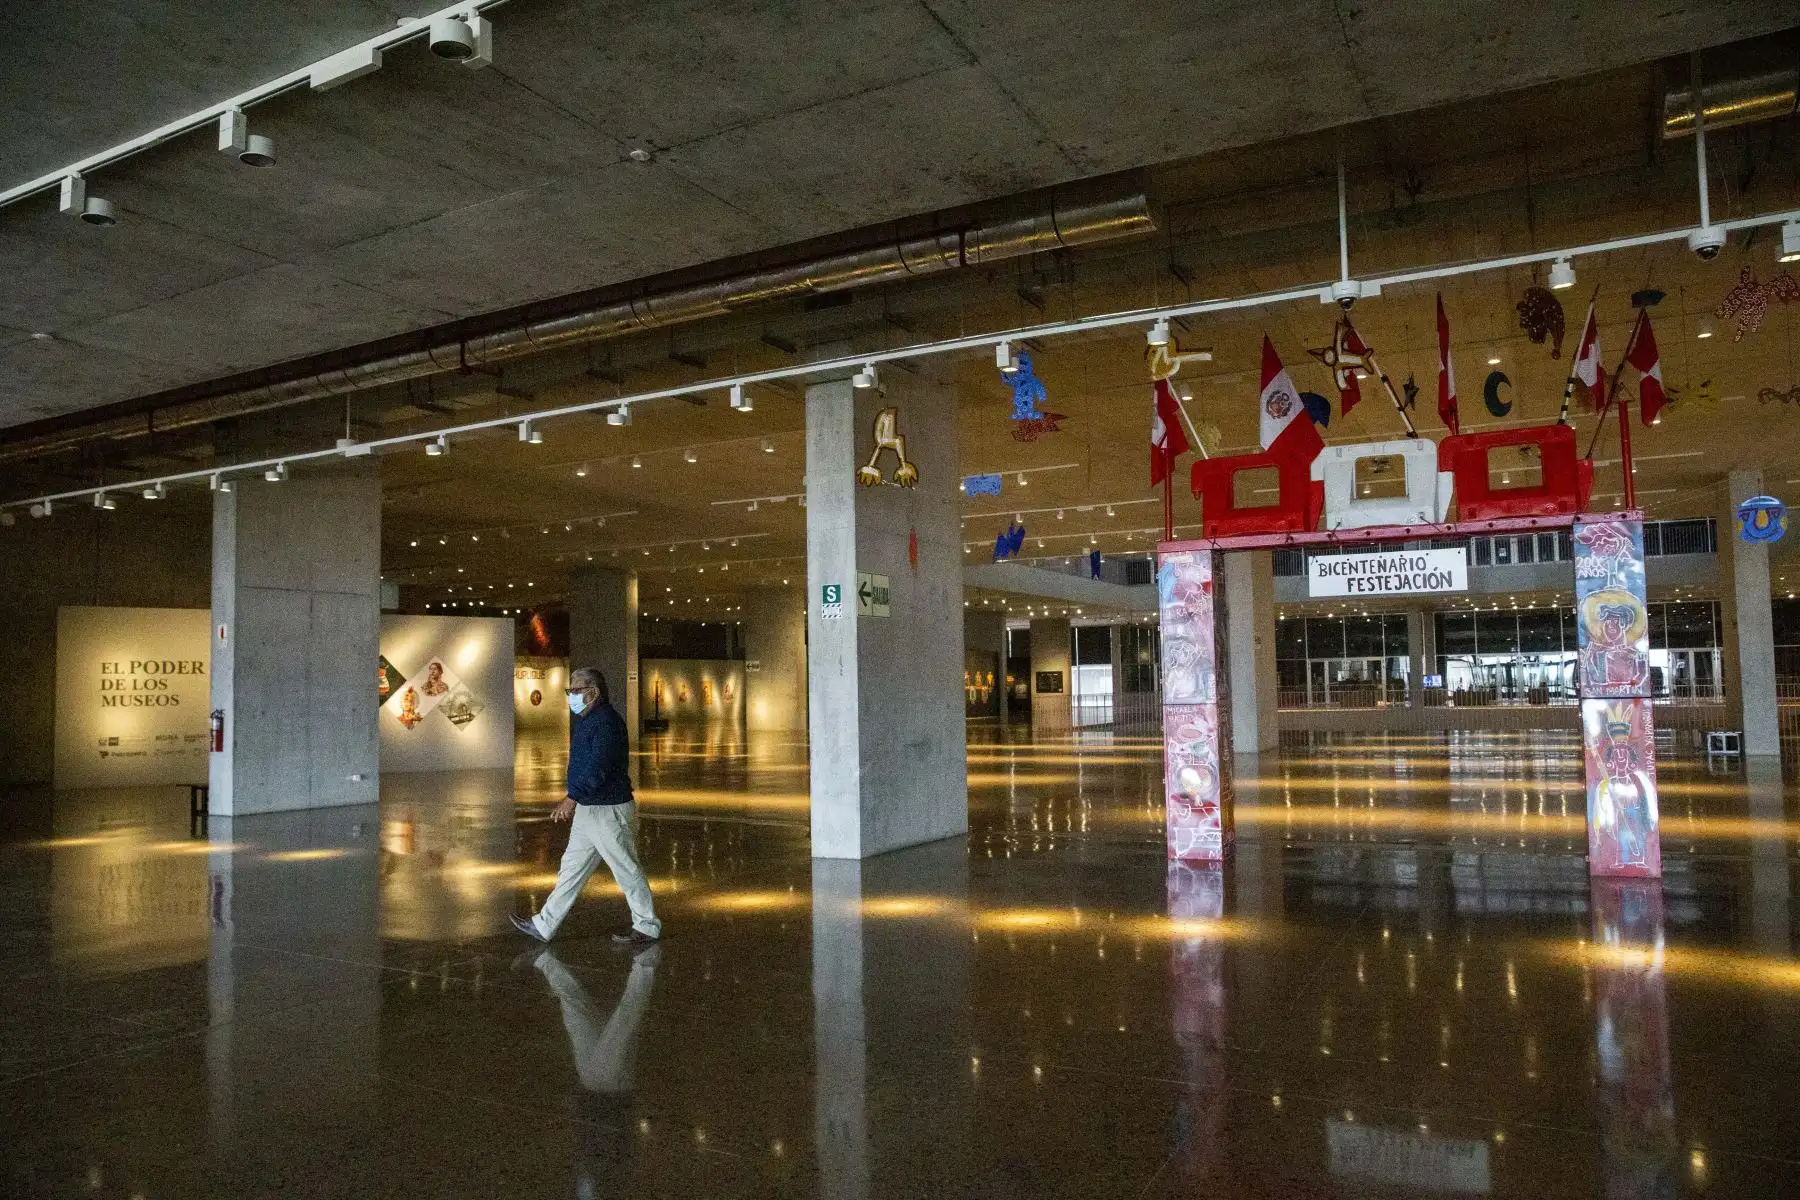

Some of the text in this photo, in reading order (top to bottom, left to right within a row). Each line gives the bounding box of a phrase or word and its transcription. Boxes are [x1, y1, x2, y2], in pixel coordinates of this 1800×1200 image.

[1318, 557, 1427, 577] BICENTENARIO
[1347, 567, 1453, 593] FESTEJACIÓN
[826, 586, 837, 602] S
[101, 660, 205, 675] EL PODER
[101, 679, 168, 691] DE LOS
[101, 694, 180, 707] MUSEOS
